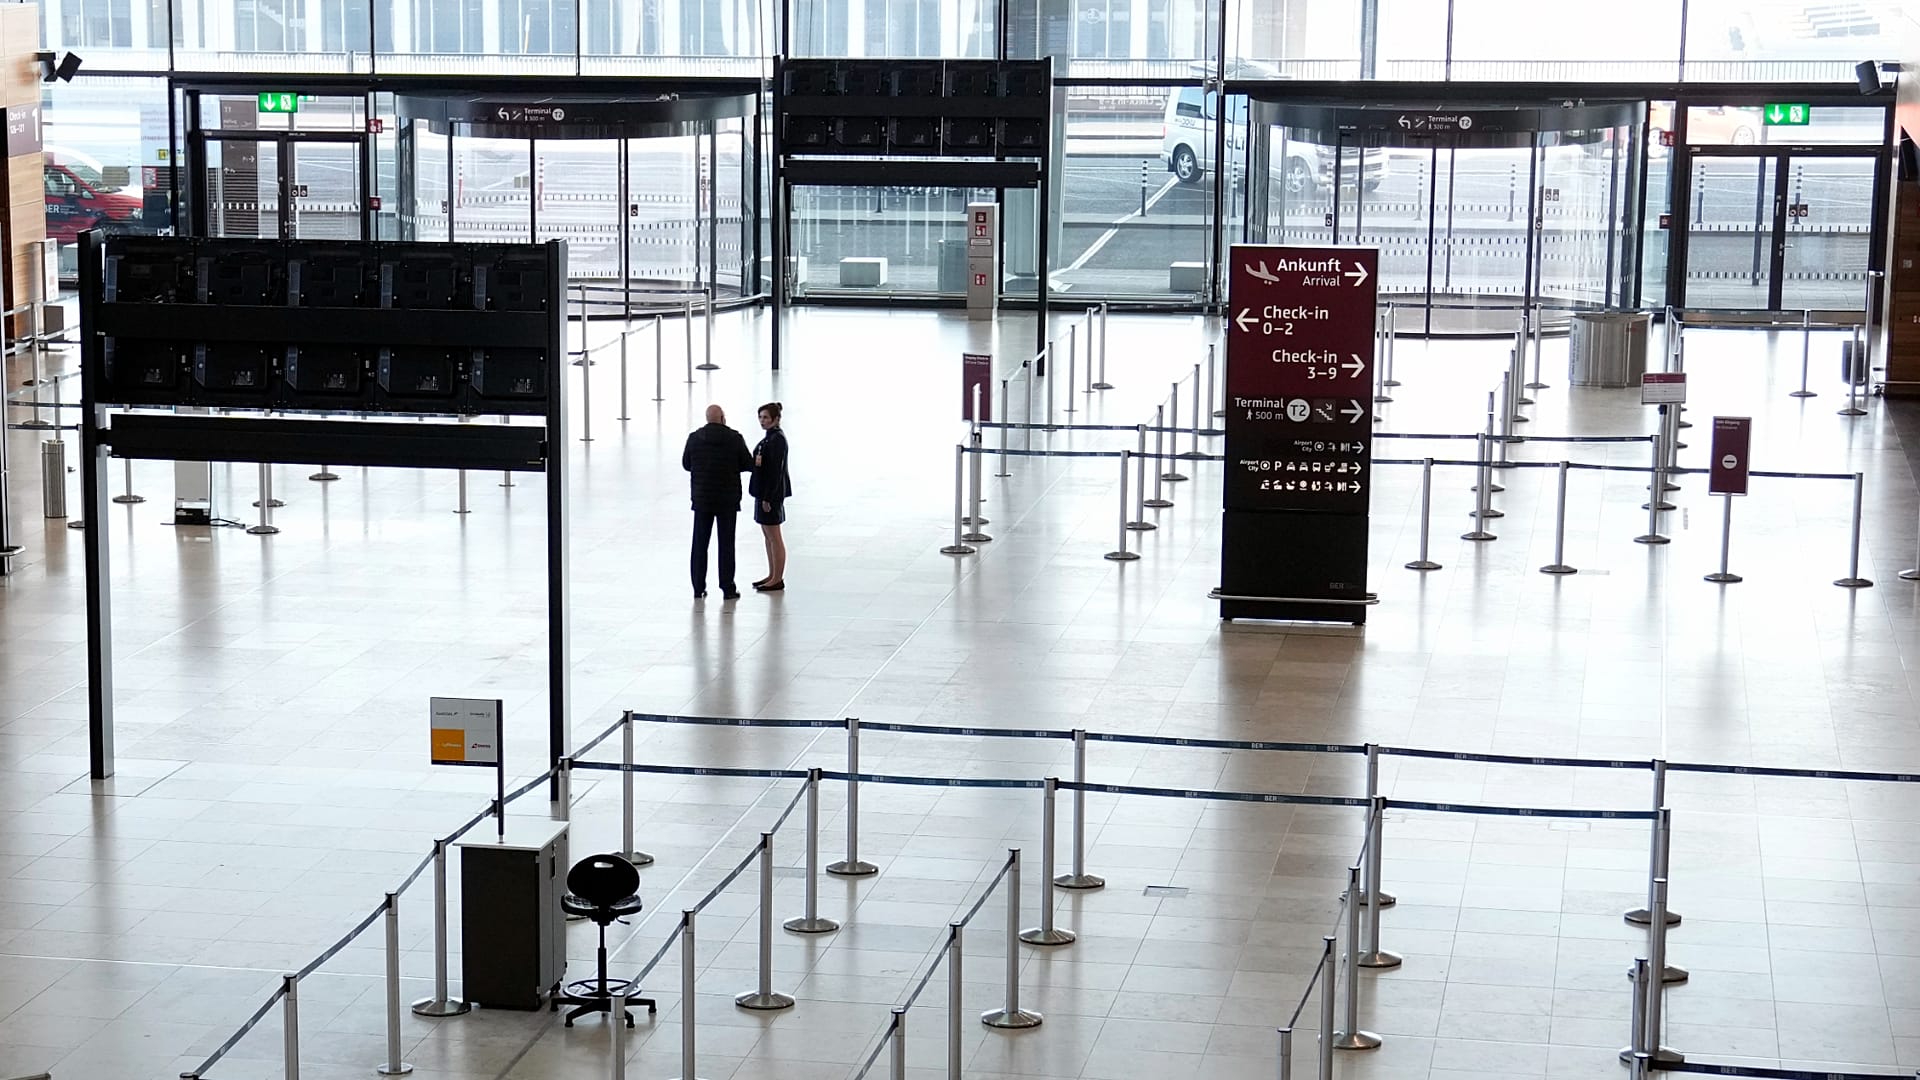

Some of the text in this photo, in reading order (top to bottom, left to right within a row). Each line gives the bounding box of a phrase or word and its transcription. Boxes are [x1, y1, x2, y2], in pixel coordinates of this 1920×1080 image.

[31, 107, 39, 142] 1
[1277, 258, 1341, 272] Ankunft
[1302, 275, 1340, 286] Arrival
[1263, 305, 1329, 320] Check-in
[1272, 349, 1337, 364] Check-in
[1234, 397, 1306, 417] Terminal T2
[1255, 411, 1272, 420] 500
